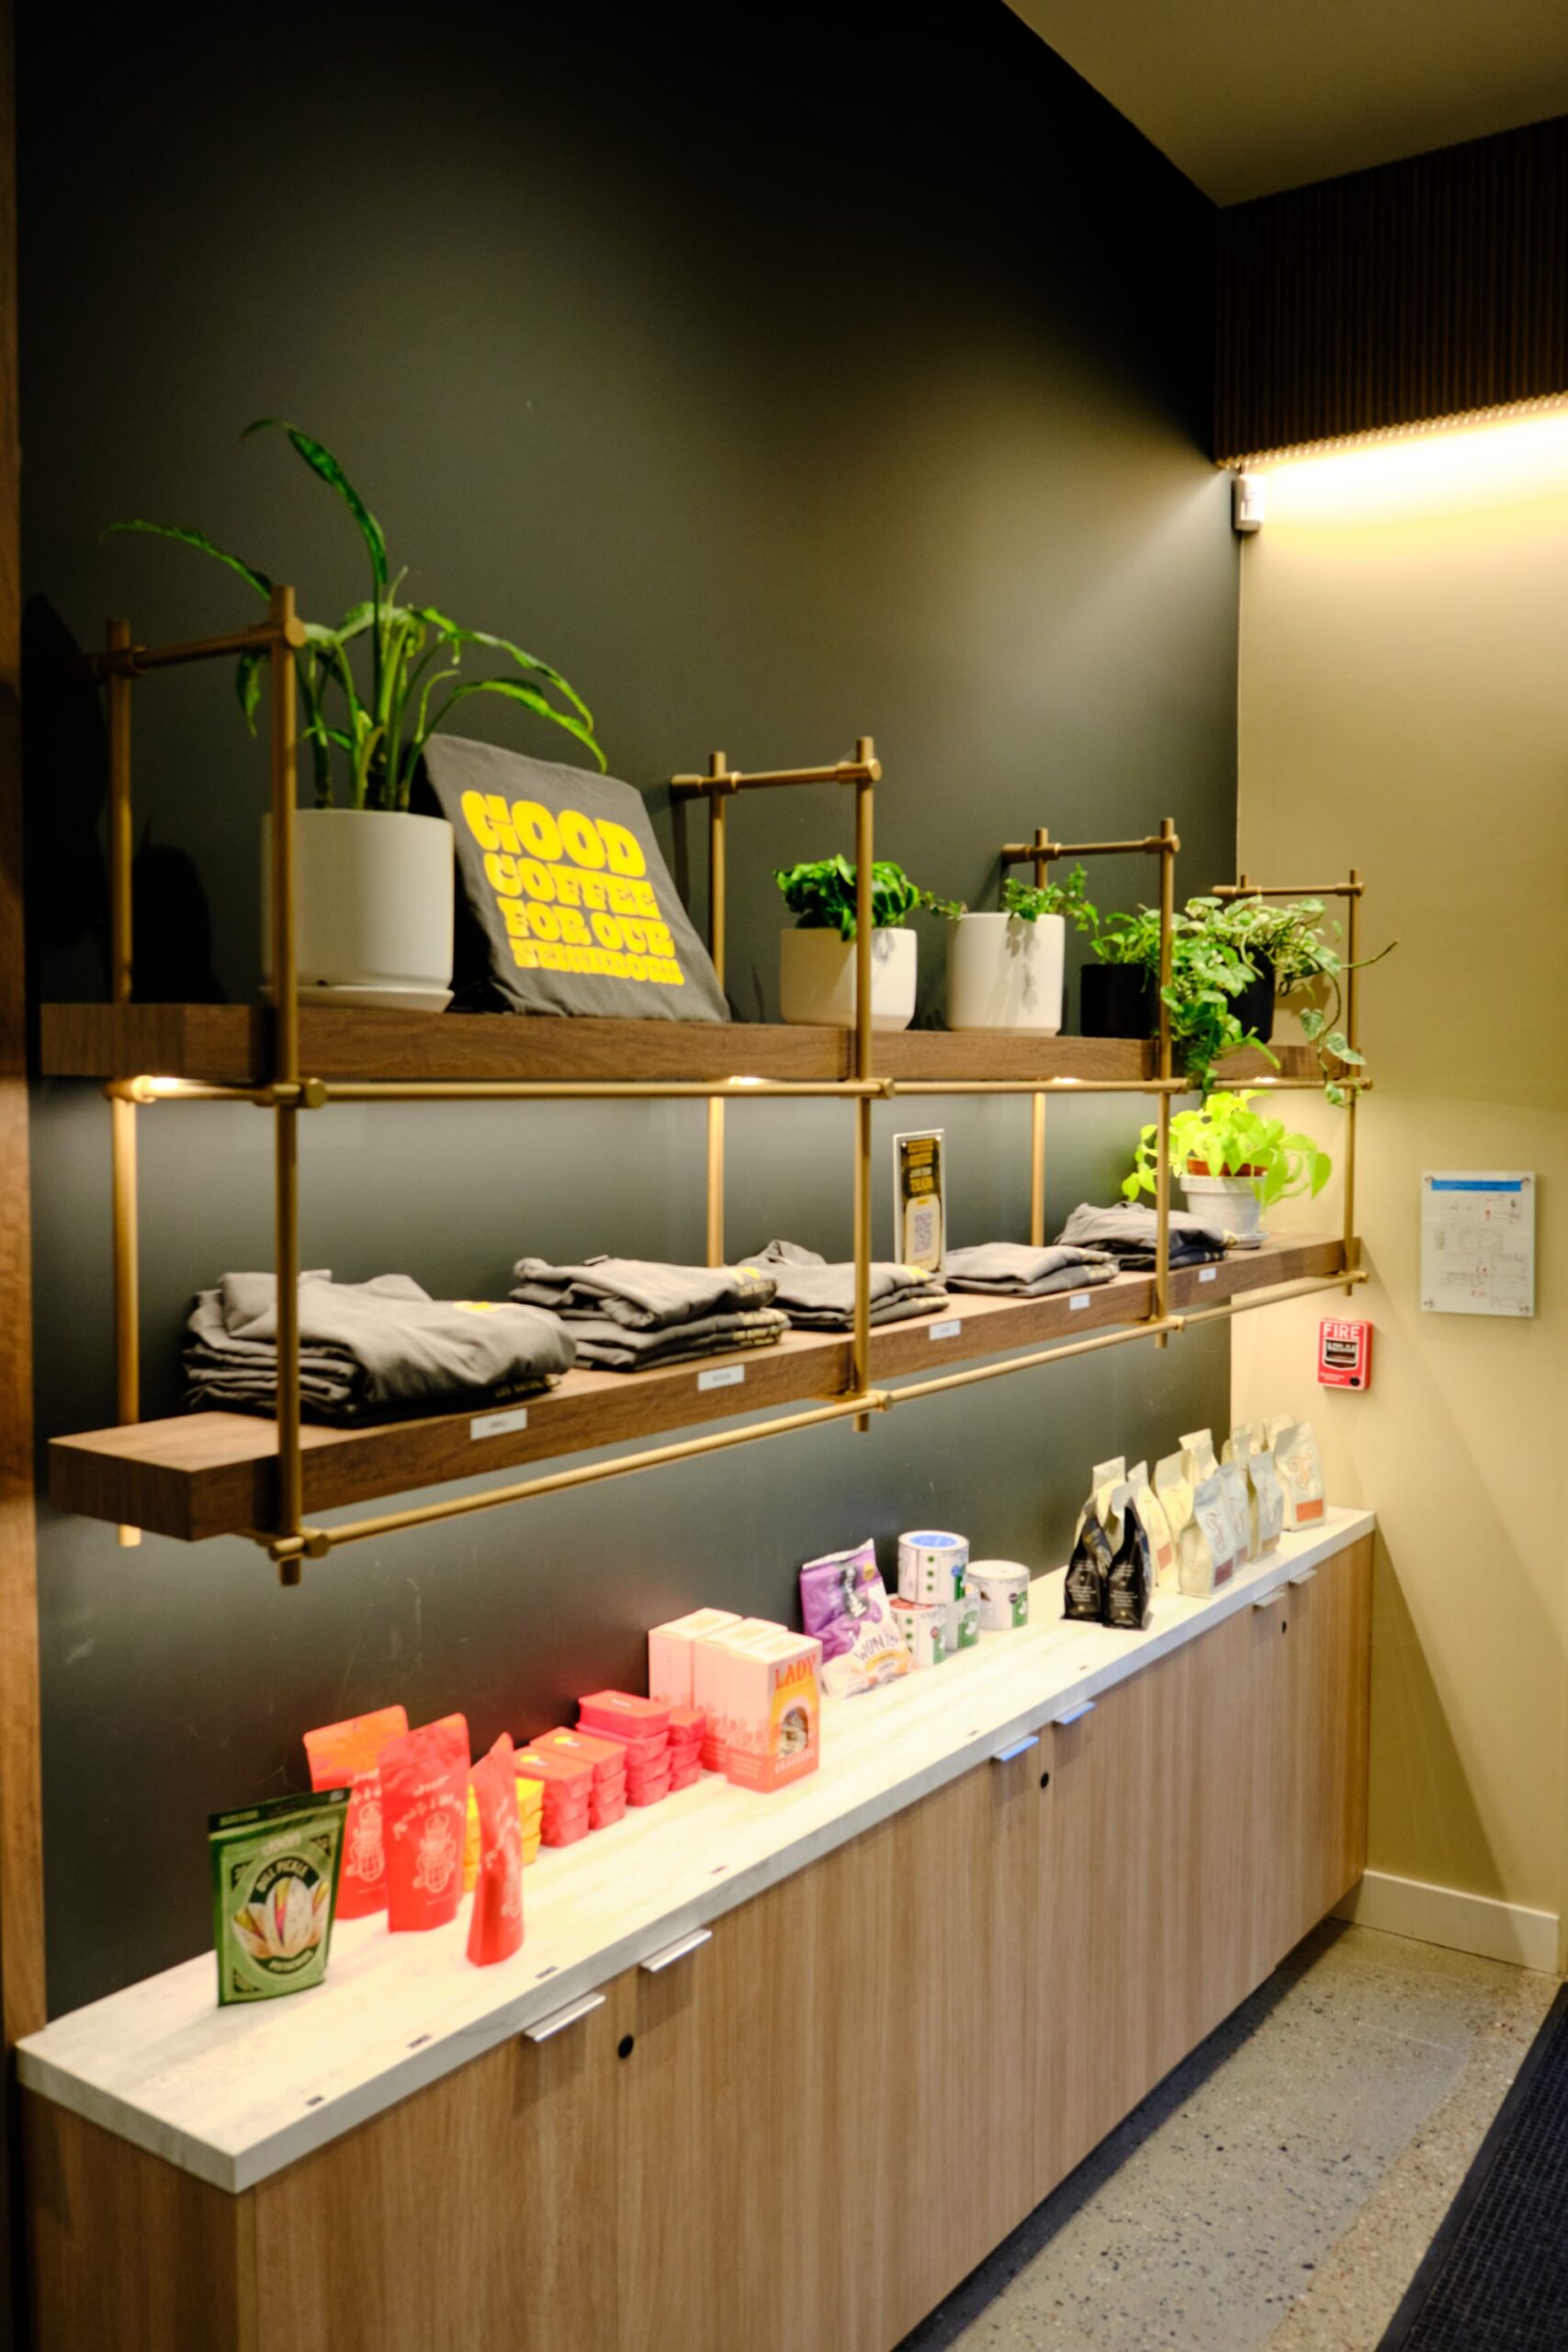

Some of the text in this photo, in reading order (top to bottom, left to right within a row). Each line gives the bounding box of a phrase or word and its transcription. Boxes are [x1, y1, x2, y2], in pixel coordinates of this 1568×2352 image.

[460, 790, 647, 877] GOOD
[483, 853, 662, 920] COFFEE
[496, 897, 675, 957] FOR OUR
[1323, 1322, 1360, 1340] FIRE
[775, 1654, 816, 1690] LADY
